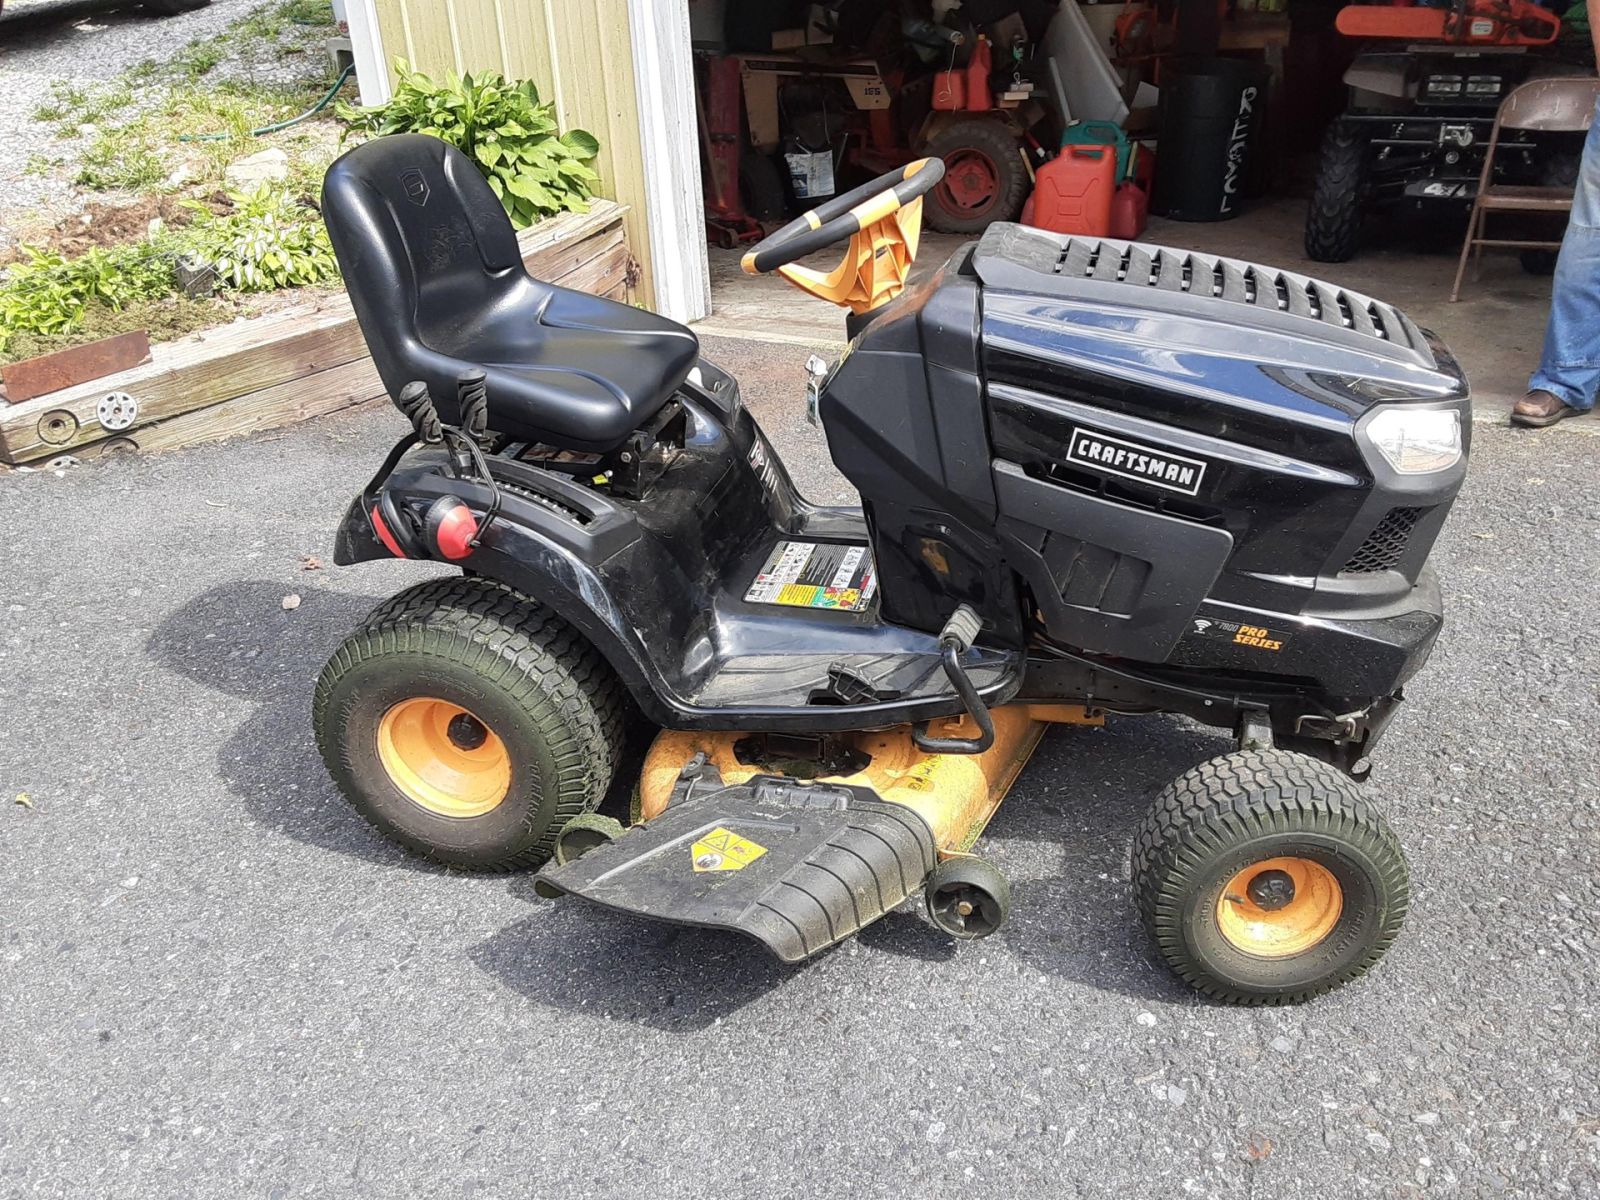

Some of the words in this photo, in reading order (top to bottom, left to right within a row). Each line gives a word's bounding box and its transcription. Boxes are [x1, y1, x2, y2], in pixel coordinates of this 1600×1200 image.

[1077, 439, 1195, 485] CRAFTSMAN
[1238, 625, 1269, 637] PRO
[1232, 634, 1283, 650] SERIES
